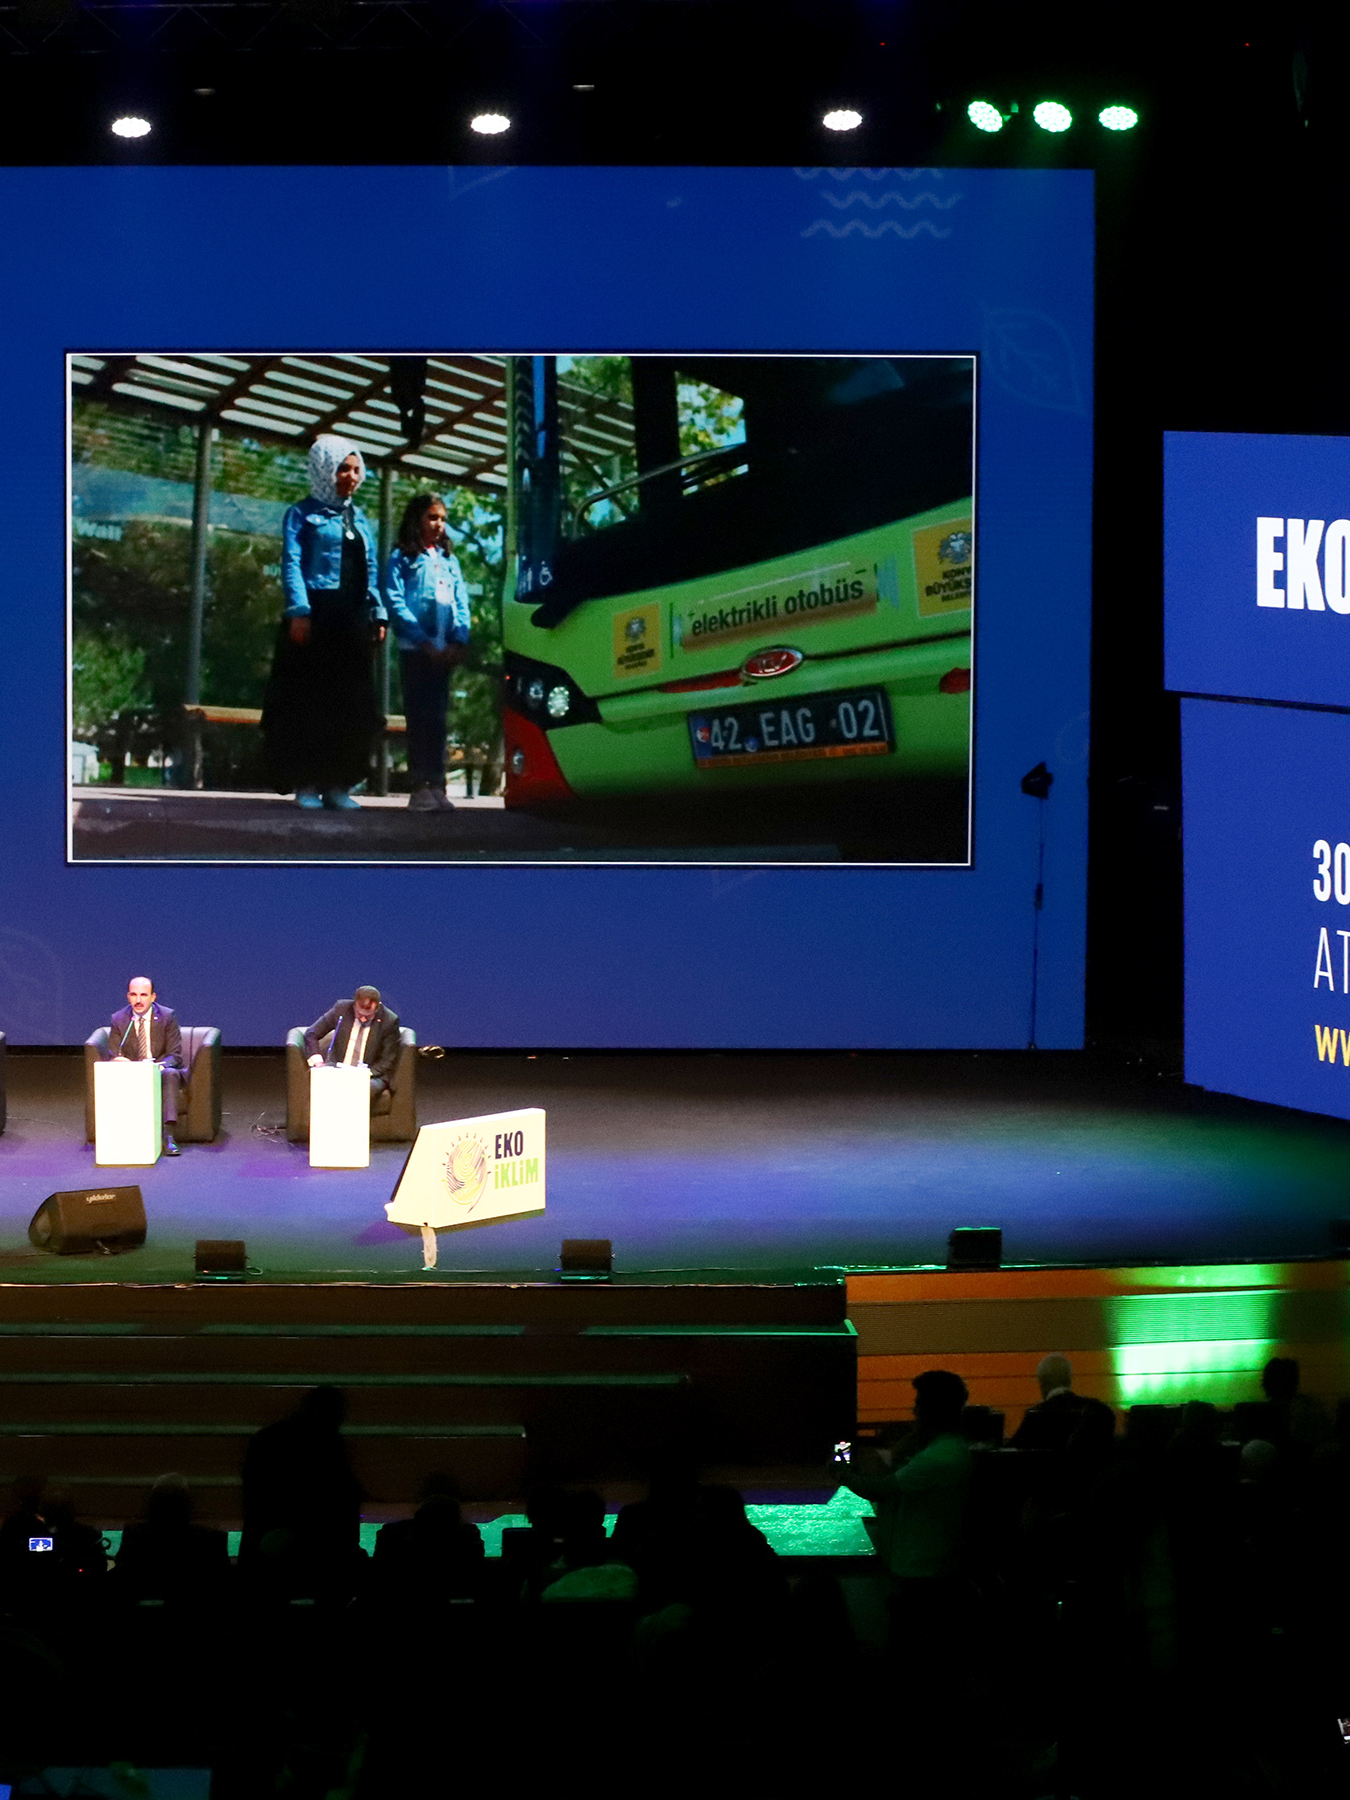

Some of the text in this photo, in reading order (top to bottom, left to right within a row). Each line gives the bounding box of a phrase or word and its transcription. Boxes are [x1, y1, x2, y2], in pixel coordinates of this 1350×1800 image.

[1256, 516, 1350, 615] EKO
[692, 578, 863, 637] elektrikli otobüs
[710, 699, 881, 750] 42 EAG 02
[1313, 839, 1350, 905] 30
[494, 1130, 524, 1159] EKO
